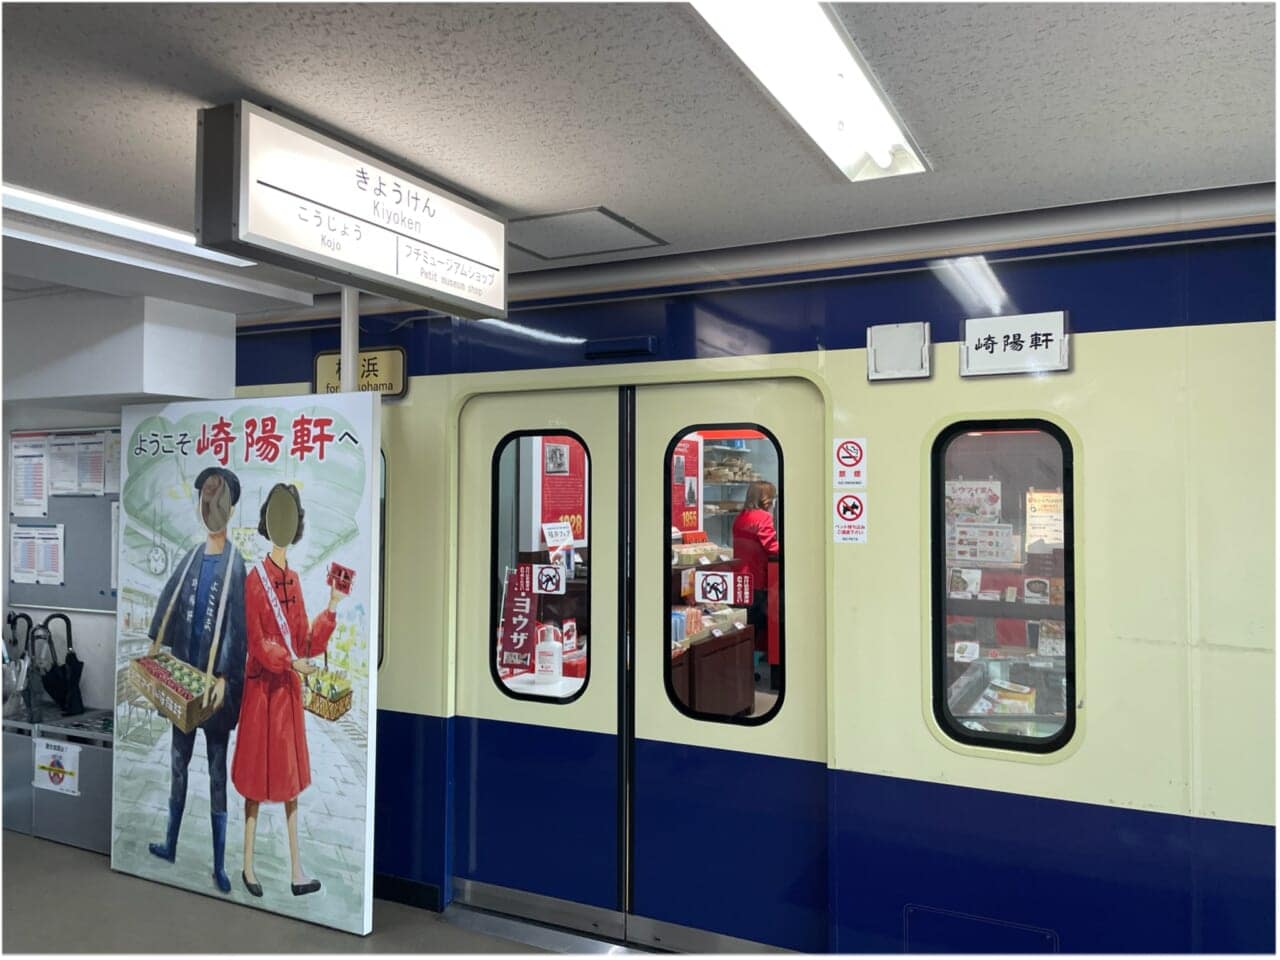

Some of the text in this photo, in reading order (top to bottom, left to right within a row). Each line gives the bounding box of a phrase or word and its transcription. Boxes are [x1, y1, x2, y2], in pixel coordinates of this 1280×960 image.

[372, 200, 421, 233] Kiyoken
[320, 234, 342, 252] Kojo
[974, 332, 1055, 355] 崎陽軒
[133, 413, 359, 466] ようこそ崎陽軒へ
